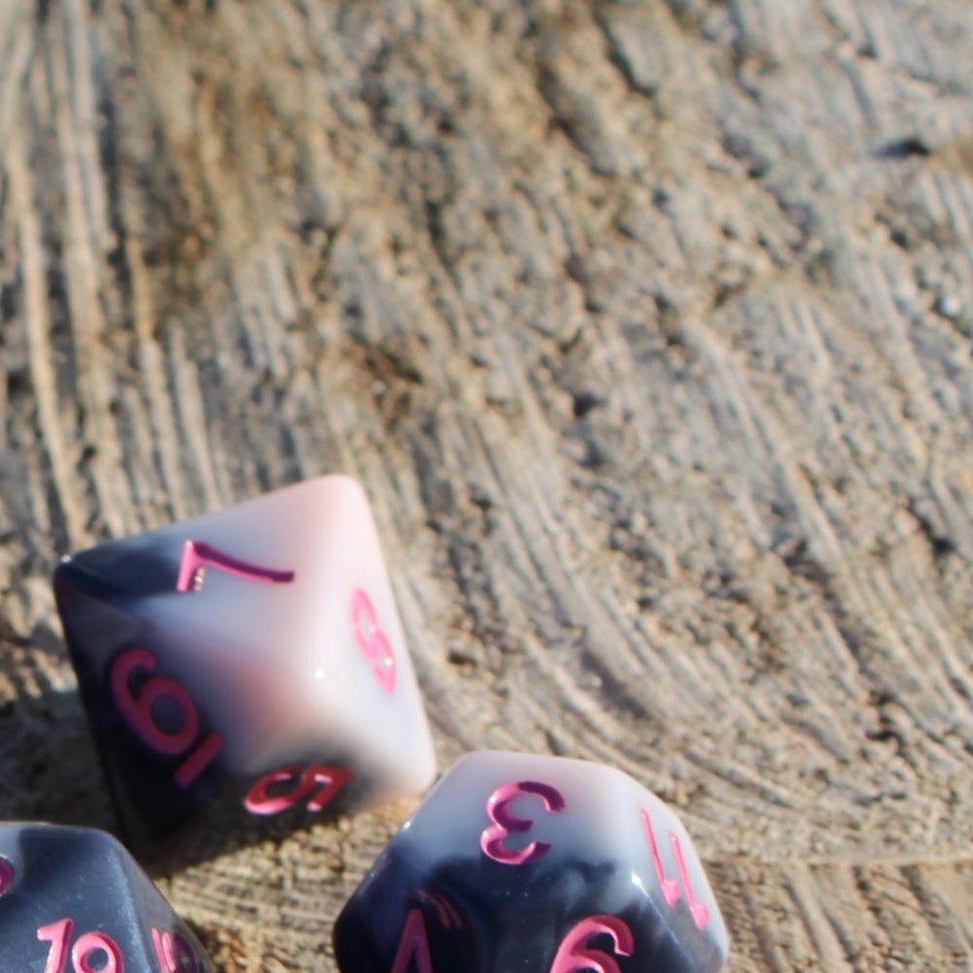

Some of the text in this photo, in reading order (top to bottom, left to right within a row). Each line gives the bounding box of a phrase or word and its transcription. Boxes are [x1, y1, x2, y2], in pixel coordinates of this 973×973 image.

[349, 588, 396, 694] 8
[244, 762, 353, 816] 5
[480, 781, 566, 865] 3
